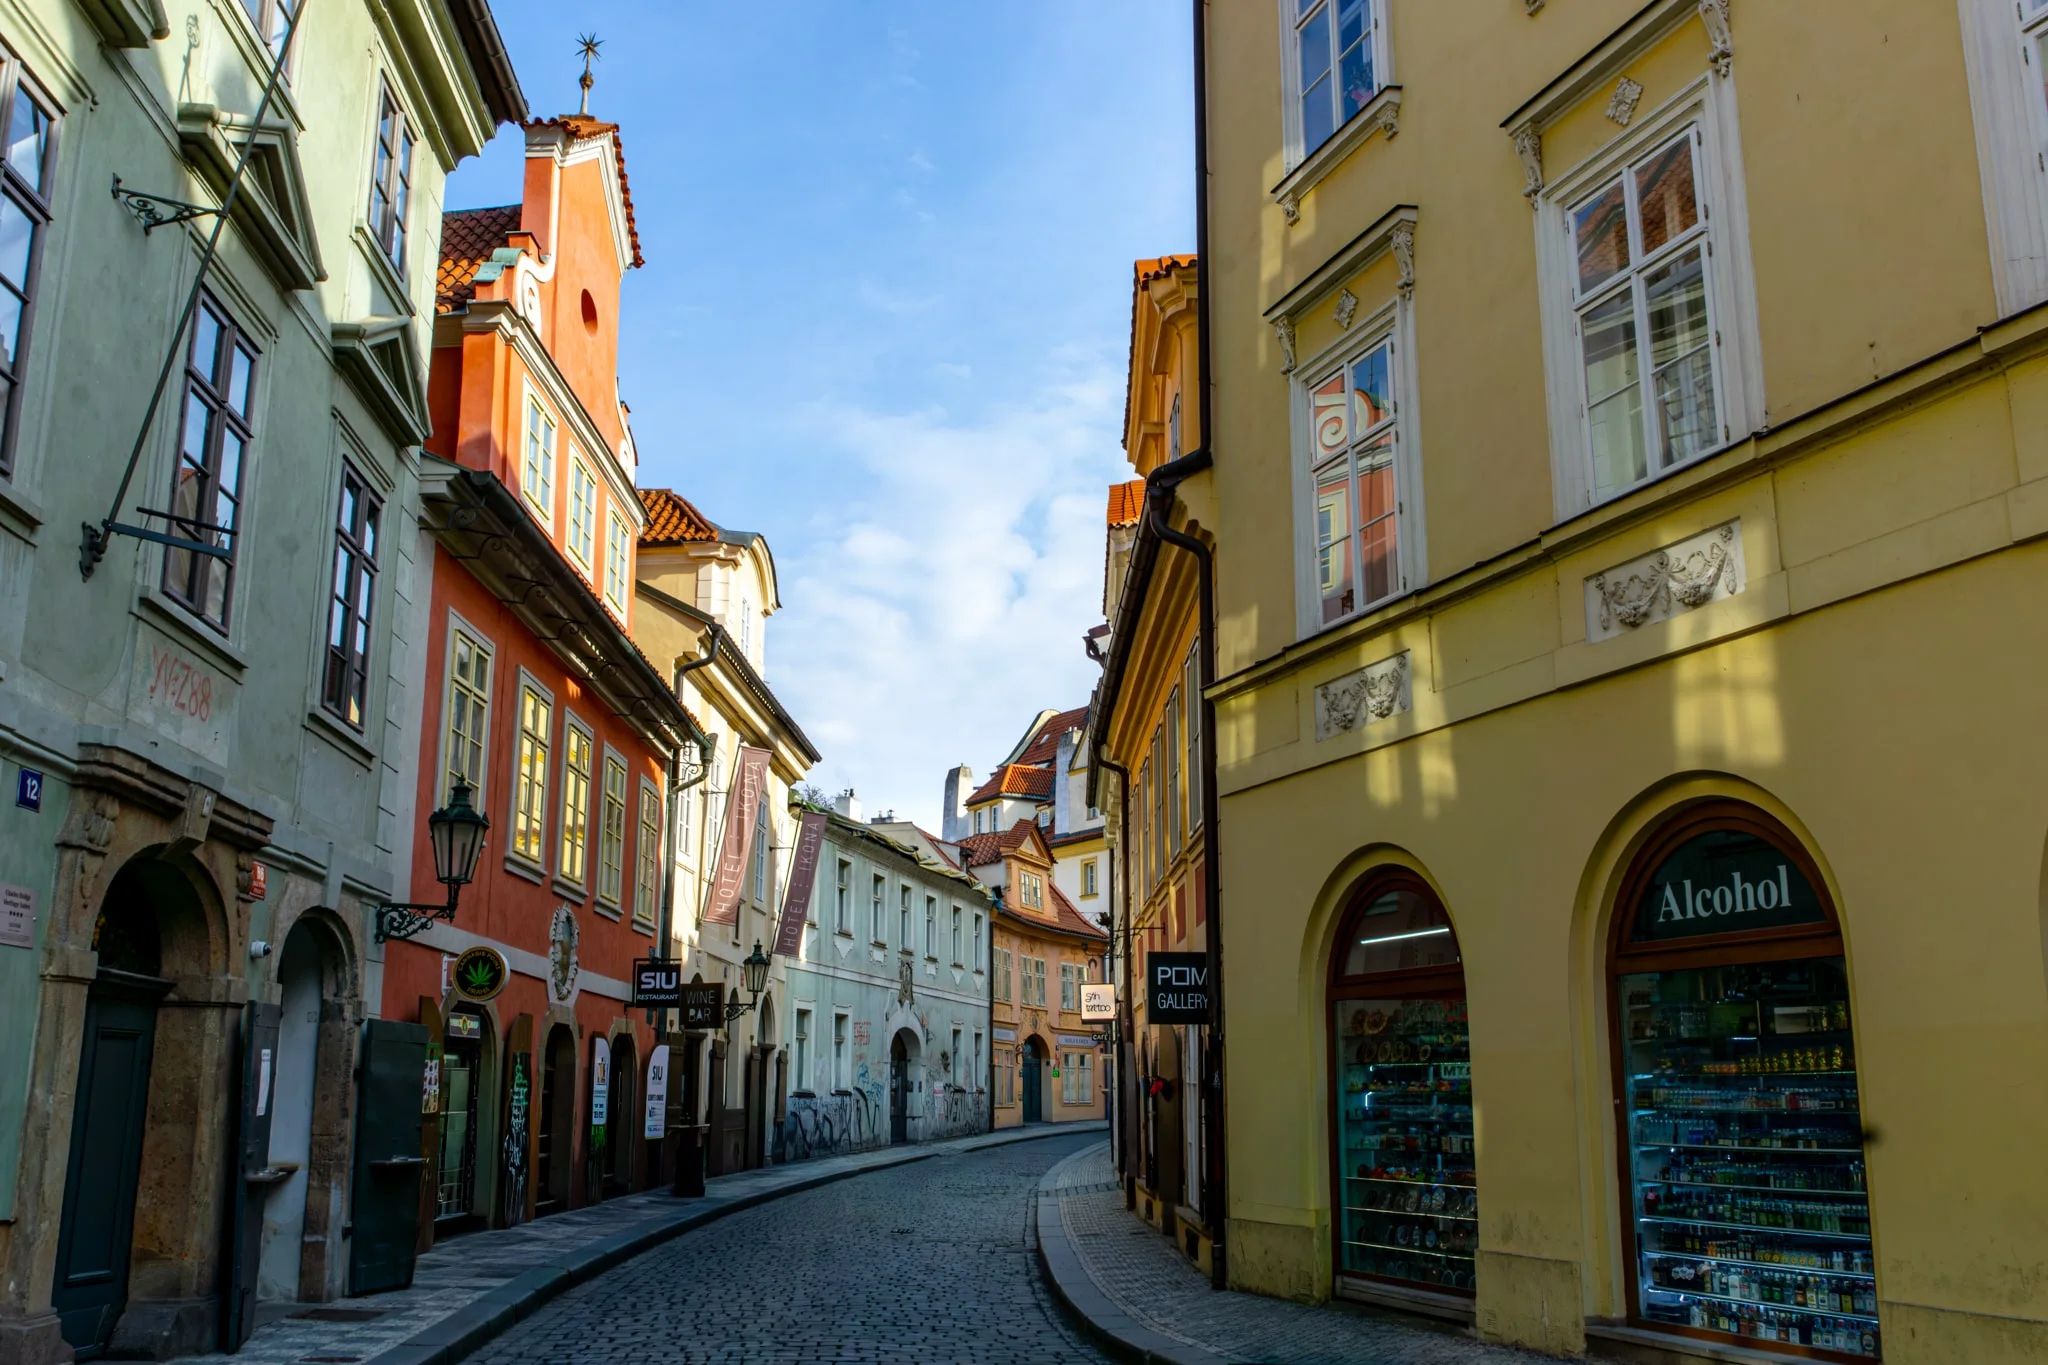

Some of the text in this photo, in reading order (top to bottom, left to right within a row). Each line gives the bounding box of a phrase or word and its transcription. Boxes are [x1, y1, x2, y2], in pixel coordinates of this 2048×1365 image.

[27, 777, 39, 800] 12
[715, 762, 761, 914] HOTEL IKONA
[783, 823, 820, 947] HOTEL IKONA
[1657, 864, 1792, 923] Alcohol
[641, 972, 677, 989] SIU
[687, 990, 715, 1004] WINE
[1157, 993, 1207, 1009] GALLERY
[688, 1008, 711, 1022] BAR
[652, 1066, 663, 1081] SIU
